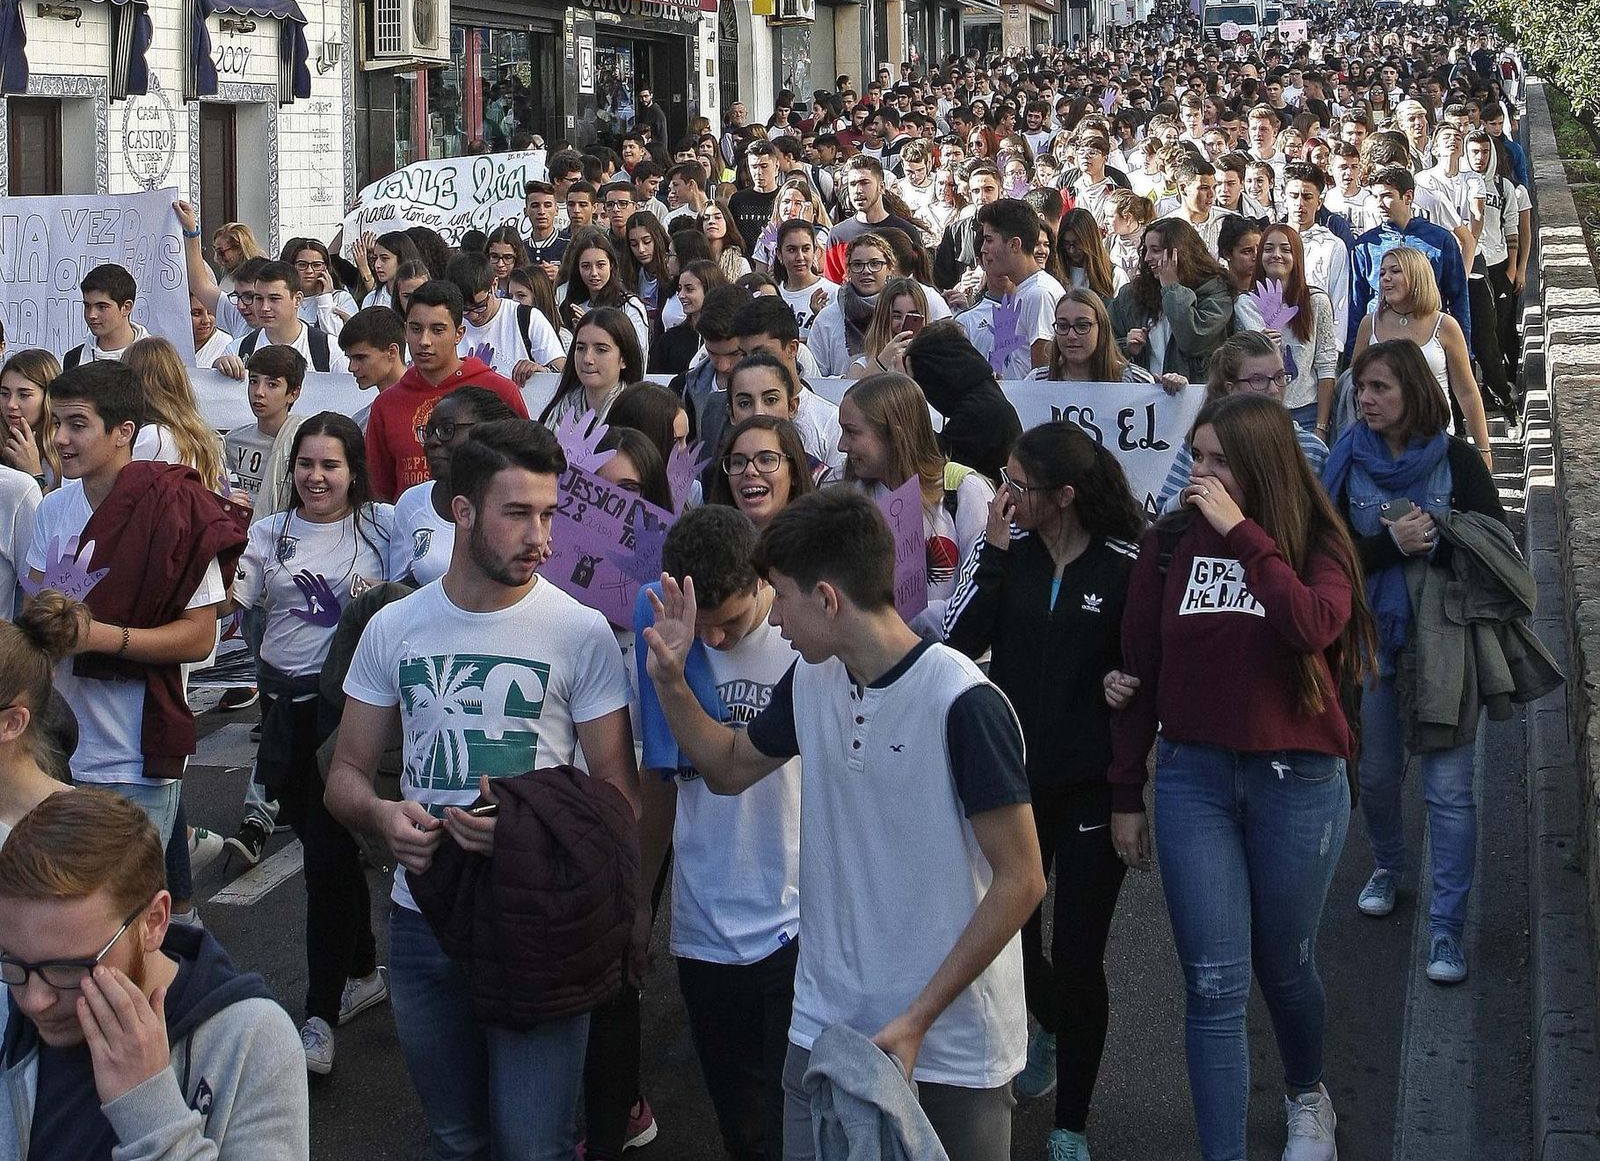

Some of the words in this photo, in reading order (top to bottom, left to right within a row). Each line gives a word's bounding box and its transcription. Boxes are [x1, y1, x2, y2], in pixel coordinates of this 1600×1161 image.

[136, 106, 160, 120] CASA
[127, 130, 170, 150] CASTRO
[61, 208, 122, 244] VEZ
[401, 205, 442, 226] tener
[1117, 402, 1171, 451] EL
[238, 447, 262, 473] YO
[559, 466, 628, 519] JESSICA
[556, 496, 588, 523] 28
